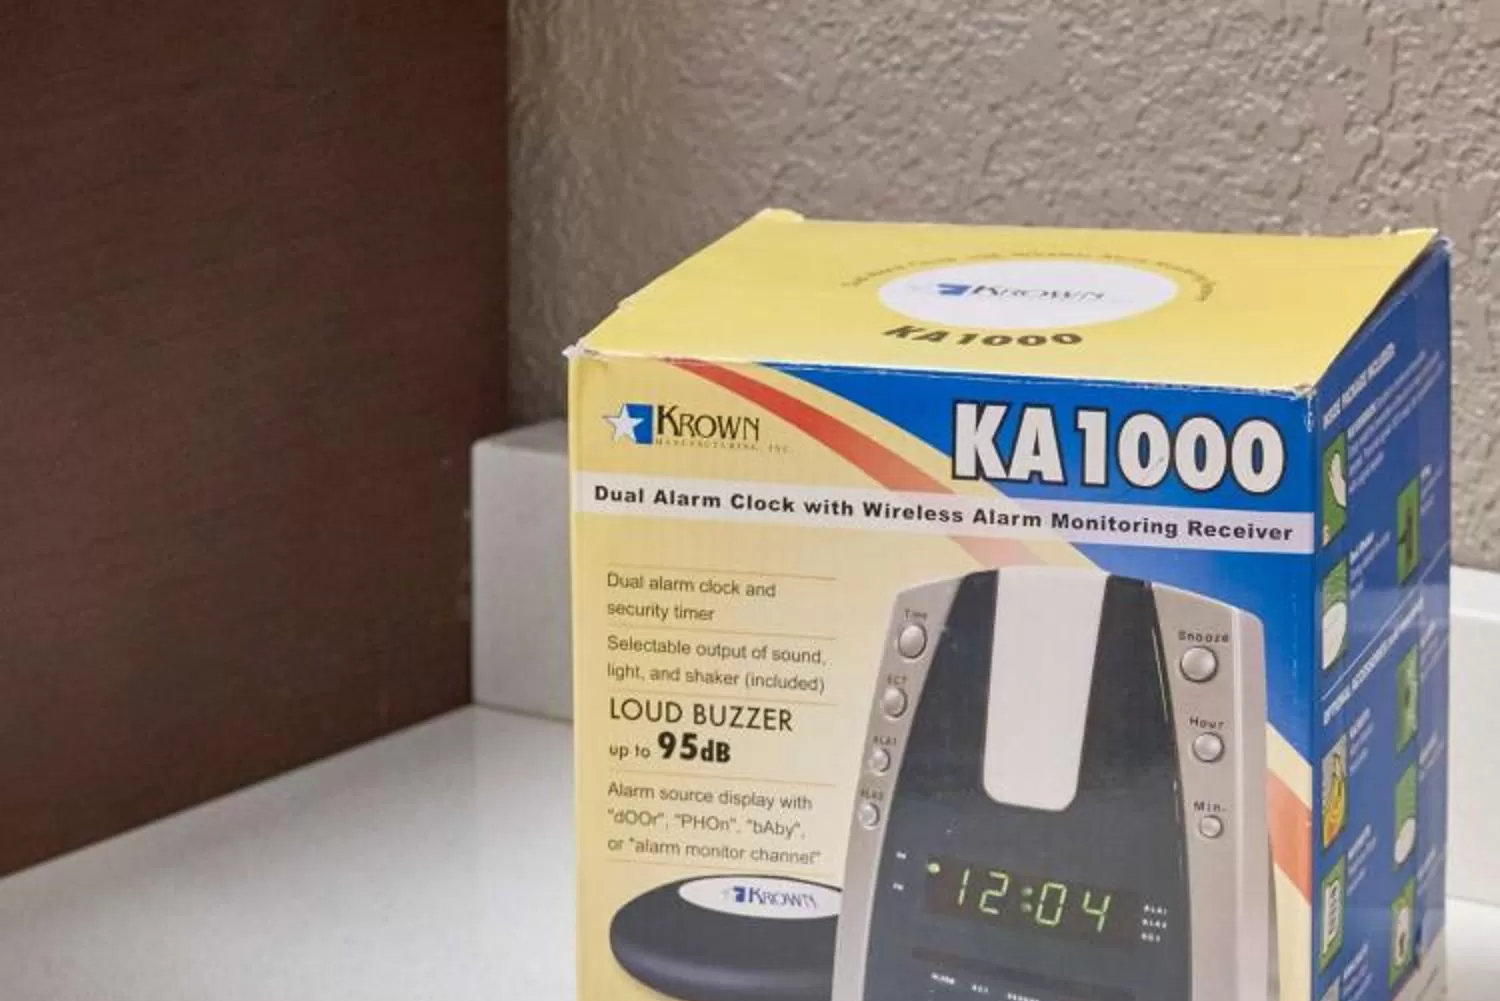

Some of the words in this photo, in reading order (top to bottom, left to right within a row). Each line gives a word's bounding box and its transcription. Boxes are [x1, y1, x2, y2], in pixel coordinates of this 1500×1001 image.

[883, 324, 1083, 347] KA1000
[656, 404, 760, 441] KROWN
[952, 401, 1287, 495] KA1000
[595, 485, 645, 503] Dual
[653, 489, 722, 509] Alarm
[730, 493, 796, 513] Clock
[804, 499, 854, 517] with
[863, 502, 964, 524] Wireless
[973, 507, 1043, 528] Alarm
[1050, 512, 1179, 538] Monitoring
[1187, 521, 1294, 541] Receiver
[607, 572, 644, 589] Dual
[649, 575, 695, 593] alarm
[699, 578, 741, 596] clock
[745, 583, 777, 598] and
[607, 601, 669, 622] security
[674, 604, 716, 621] timer
[607, 635, 691, 655] Selectable
[695, 641, 748, 661] output
[751, 645, 769, 660] of
[771, 648, 825, 666] sound,
[1178, 630, 1229, 643] Snooze
[607, 663, 645, 681] light,
[649, 666, 681, 682] and
[685, 668, 741, 687] shaker
[745, 671, 825, 695] (included)
[609, 697, 684, 724] LOUD
[693, 702, 794, 732] BUZZER
[1190, 716, 1225, 729] Hour
[609, 744, 630, 761] up
[635, 743, 652, 758] to
[607, 780, 655, 799] Alarm
[660, 786, 714, 803] source
[718, 788, 775, 810] display
[780, 794, 813, 811] with
[608, 838, 625, 851] or
[629, 836, 681, 856] "alarm
[685, 842, 747, 861] monitor
[957, 868, 1111, 932] 12:04
